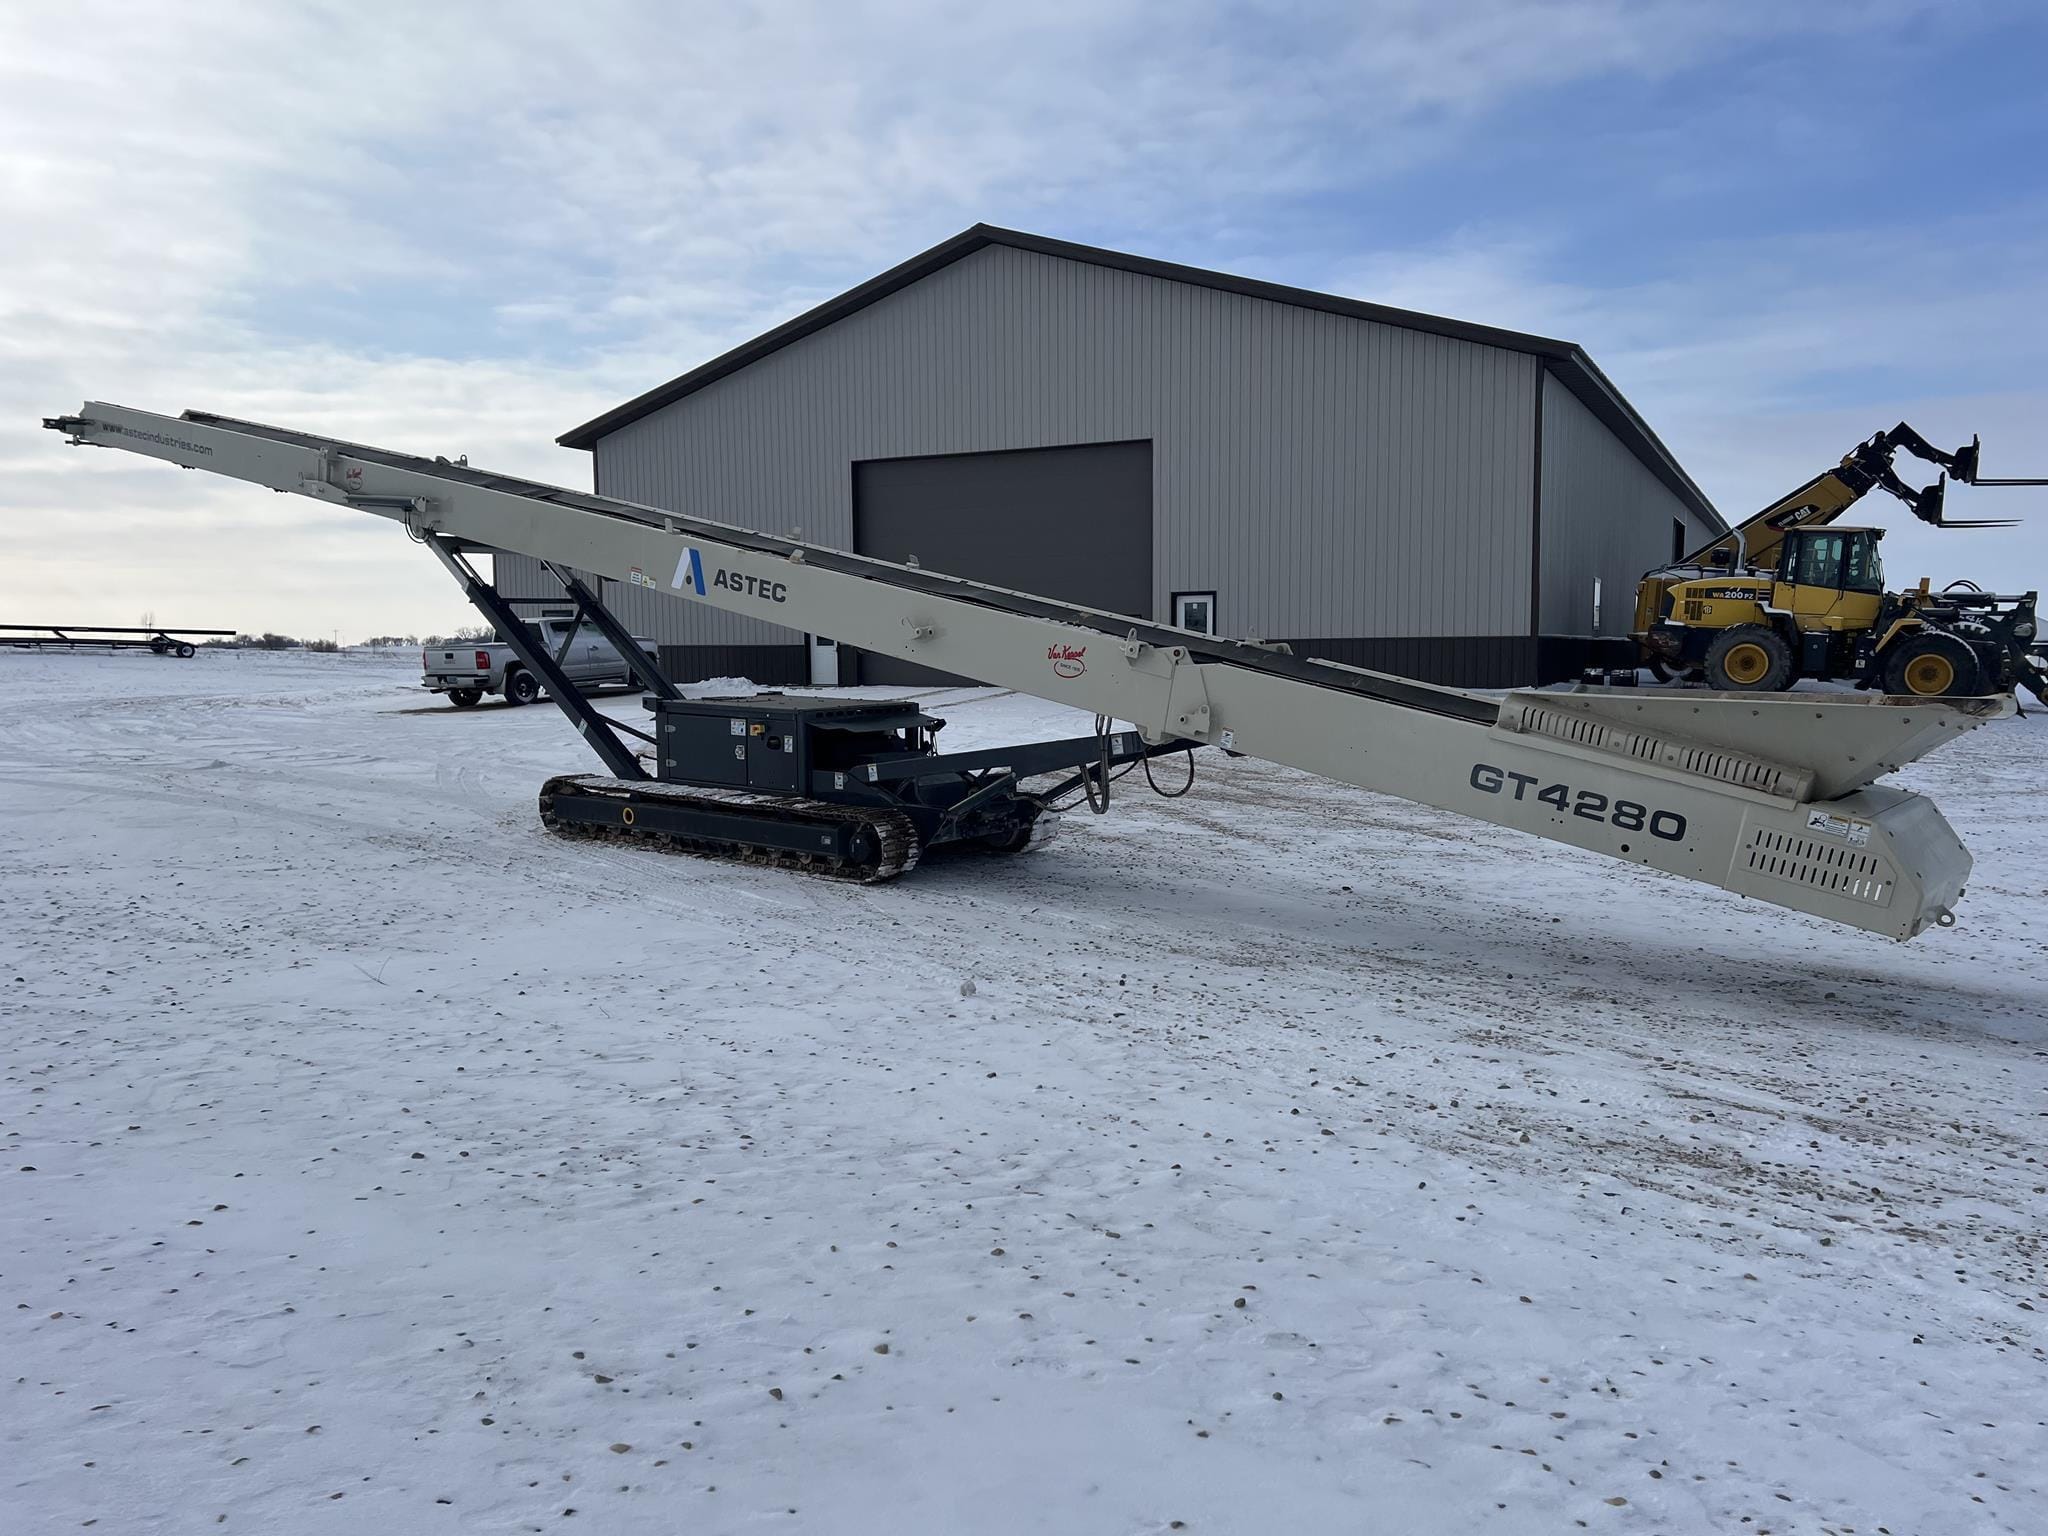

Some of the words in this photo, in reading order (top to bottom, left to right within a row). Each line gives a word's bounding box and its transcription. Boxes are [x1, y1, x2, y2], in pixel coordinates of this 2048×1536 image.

[101, 421, 214, 457] www.astecindustries.com
[1794, 505, 1812, 521] CAT
[713, 568, 787, 603] ASTEC
[1469, 763, 1688, 842] GT4280
